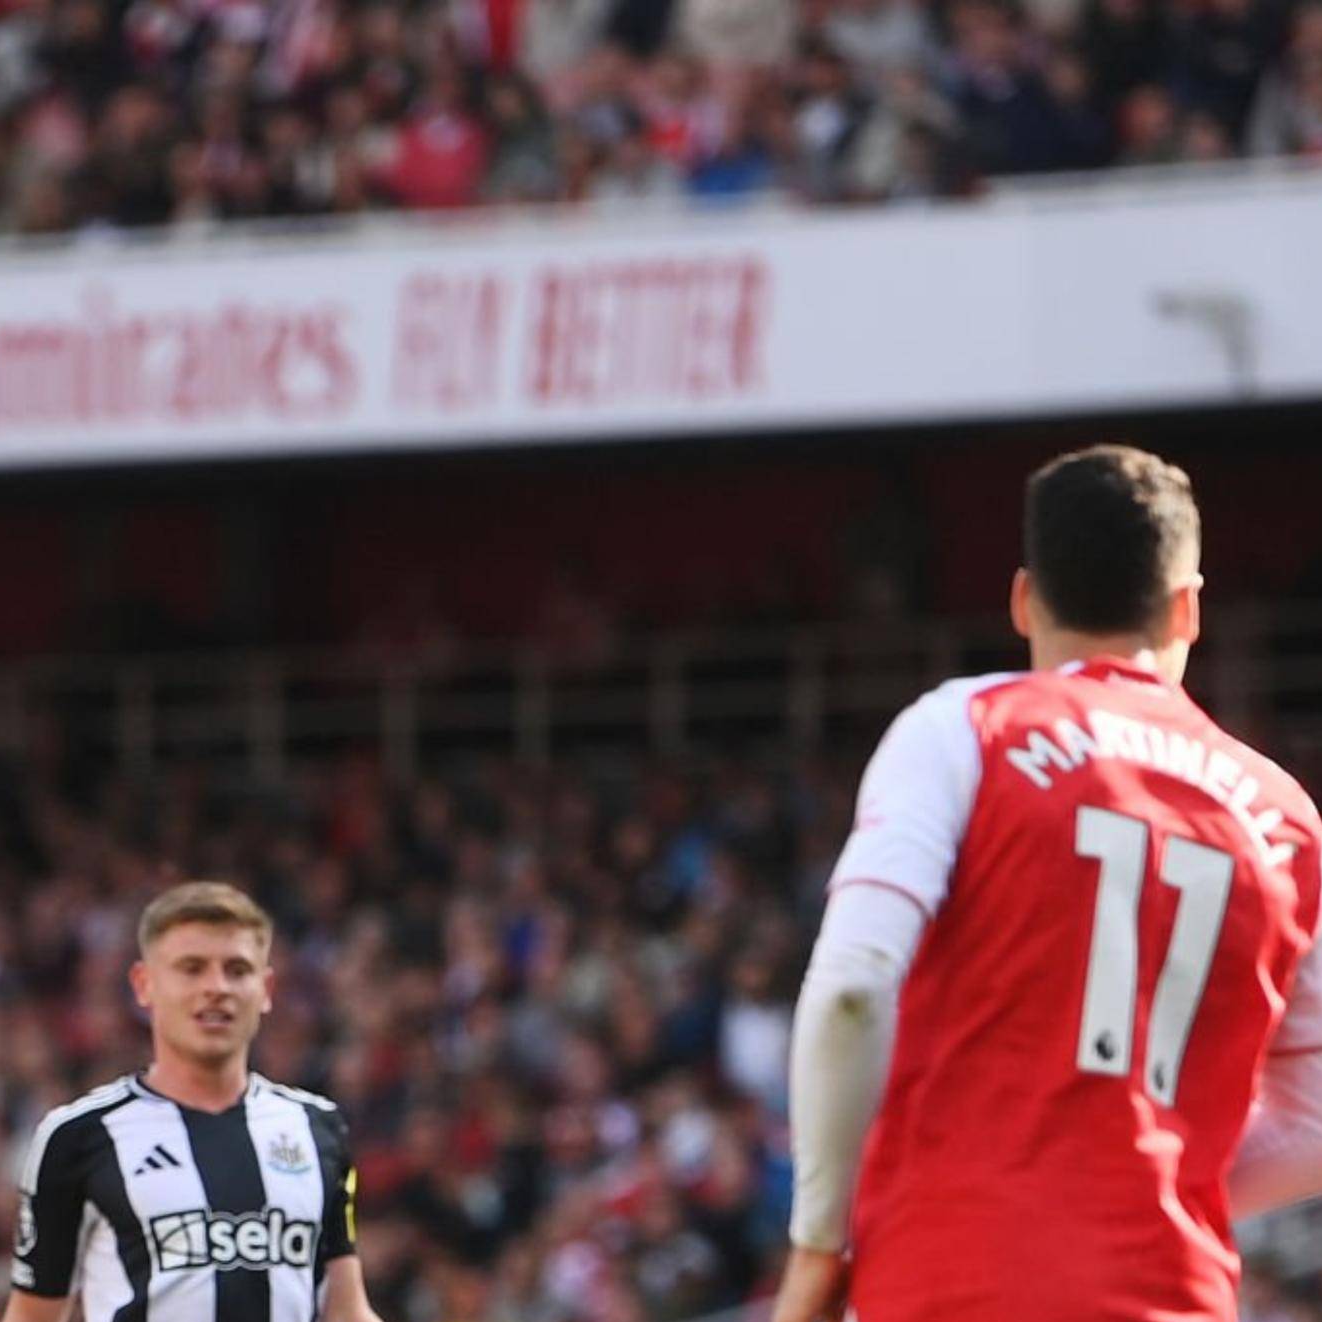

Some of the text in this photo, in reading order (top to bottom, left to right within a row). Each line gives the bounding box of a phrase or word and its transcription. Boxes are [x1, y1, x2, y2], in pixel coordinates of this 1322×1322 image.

[525, 257, 770, 406] BETTER
[1075, 804, 1235, 1108] 11
[207, 1209, 315, 1268] sela
